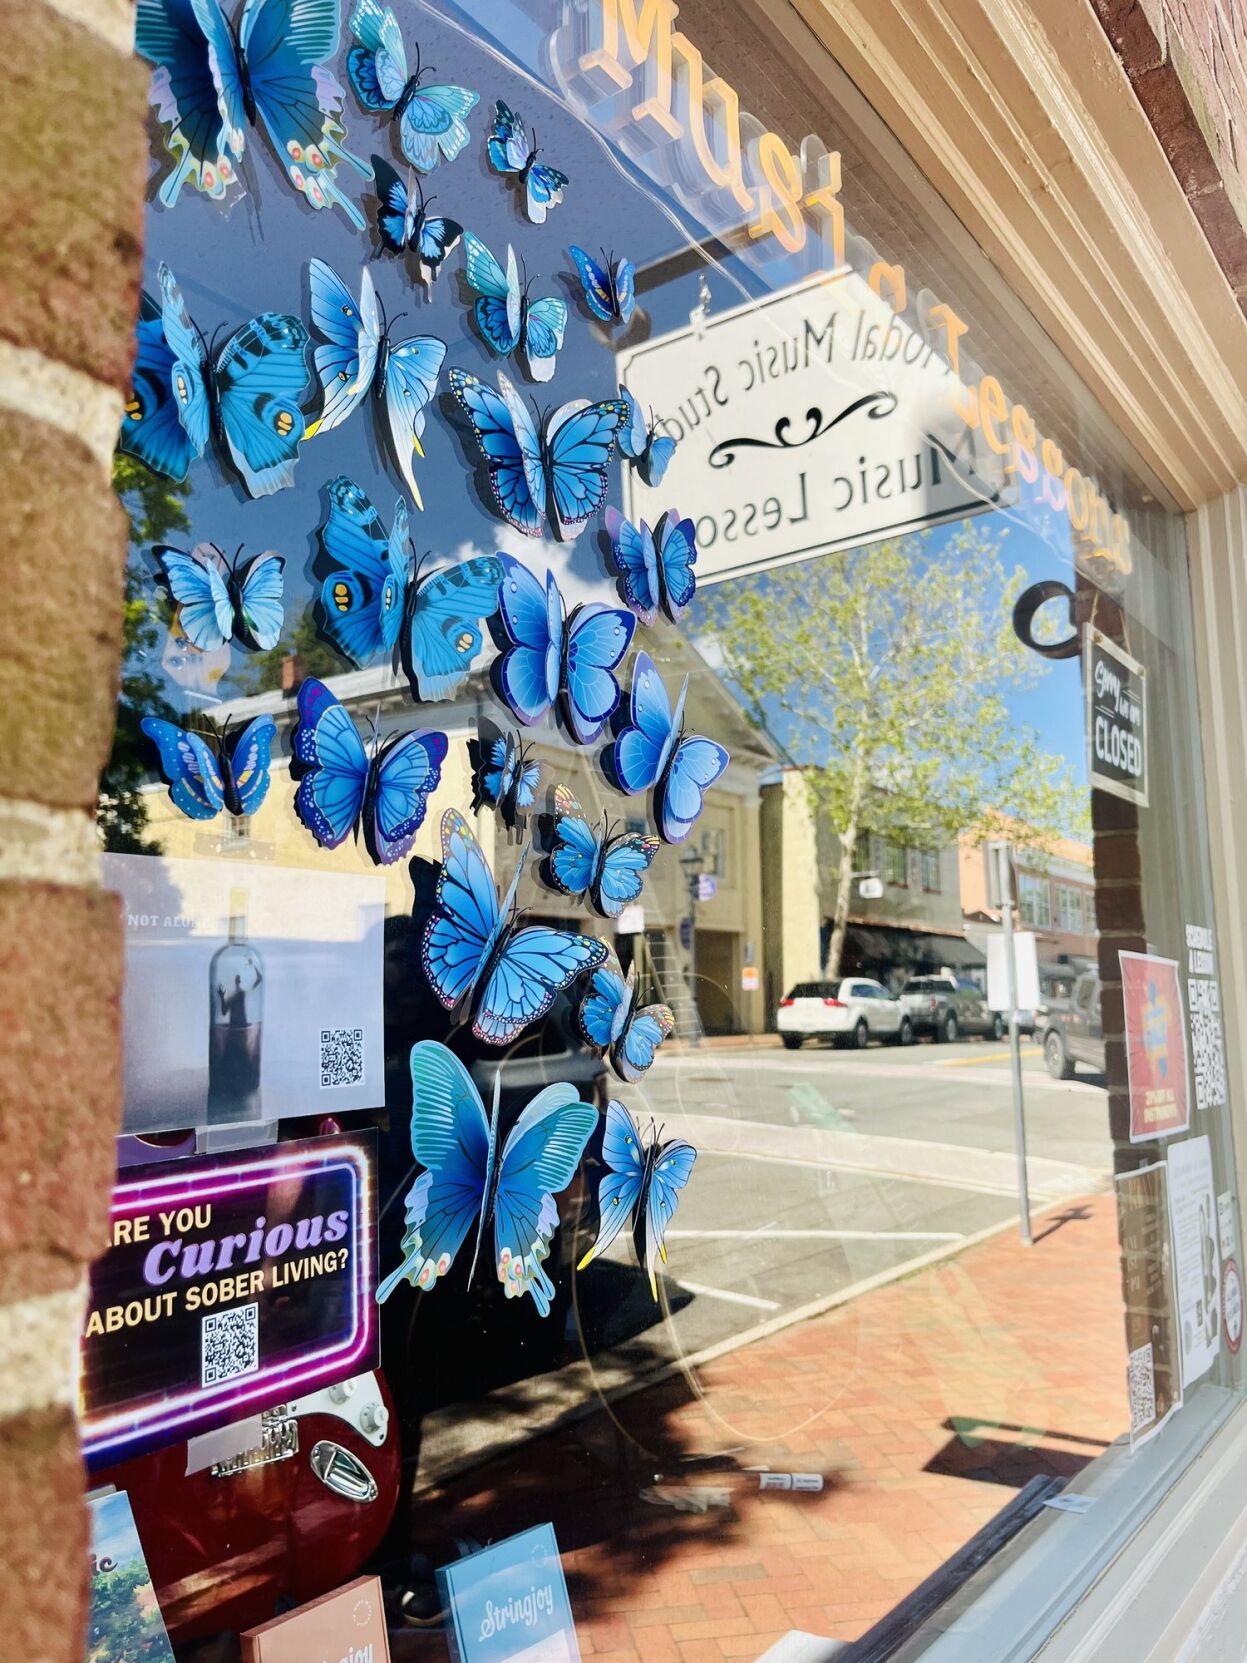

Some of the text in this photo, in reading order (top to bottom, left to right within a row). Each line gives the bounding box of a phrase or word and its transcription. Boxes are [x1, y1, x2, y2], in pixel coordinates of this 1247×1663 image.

[1095, 716, 1141, 777] CLOSED
[127, 914, 200, 928] NOT ALO
[107, 1204, 212, 1248] RE YOU
[142, 1209, 349, 1286] Curious
[85, 1248, 349, 1338] ABOUT SOBER LIVING?
[478, 1584, 554, 1643] Stringjoy
